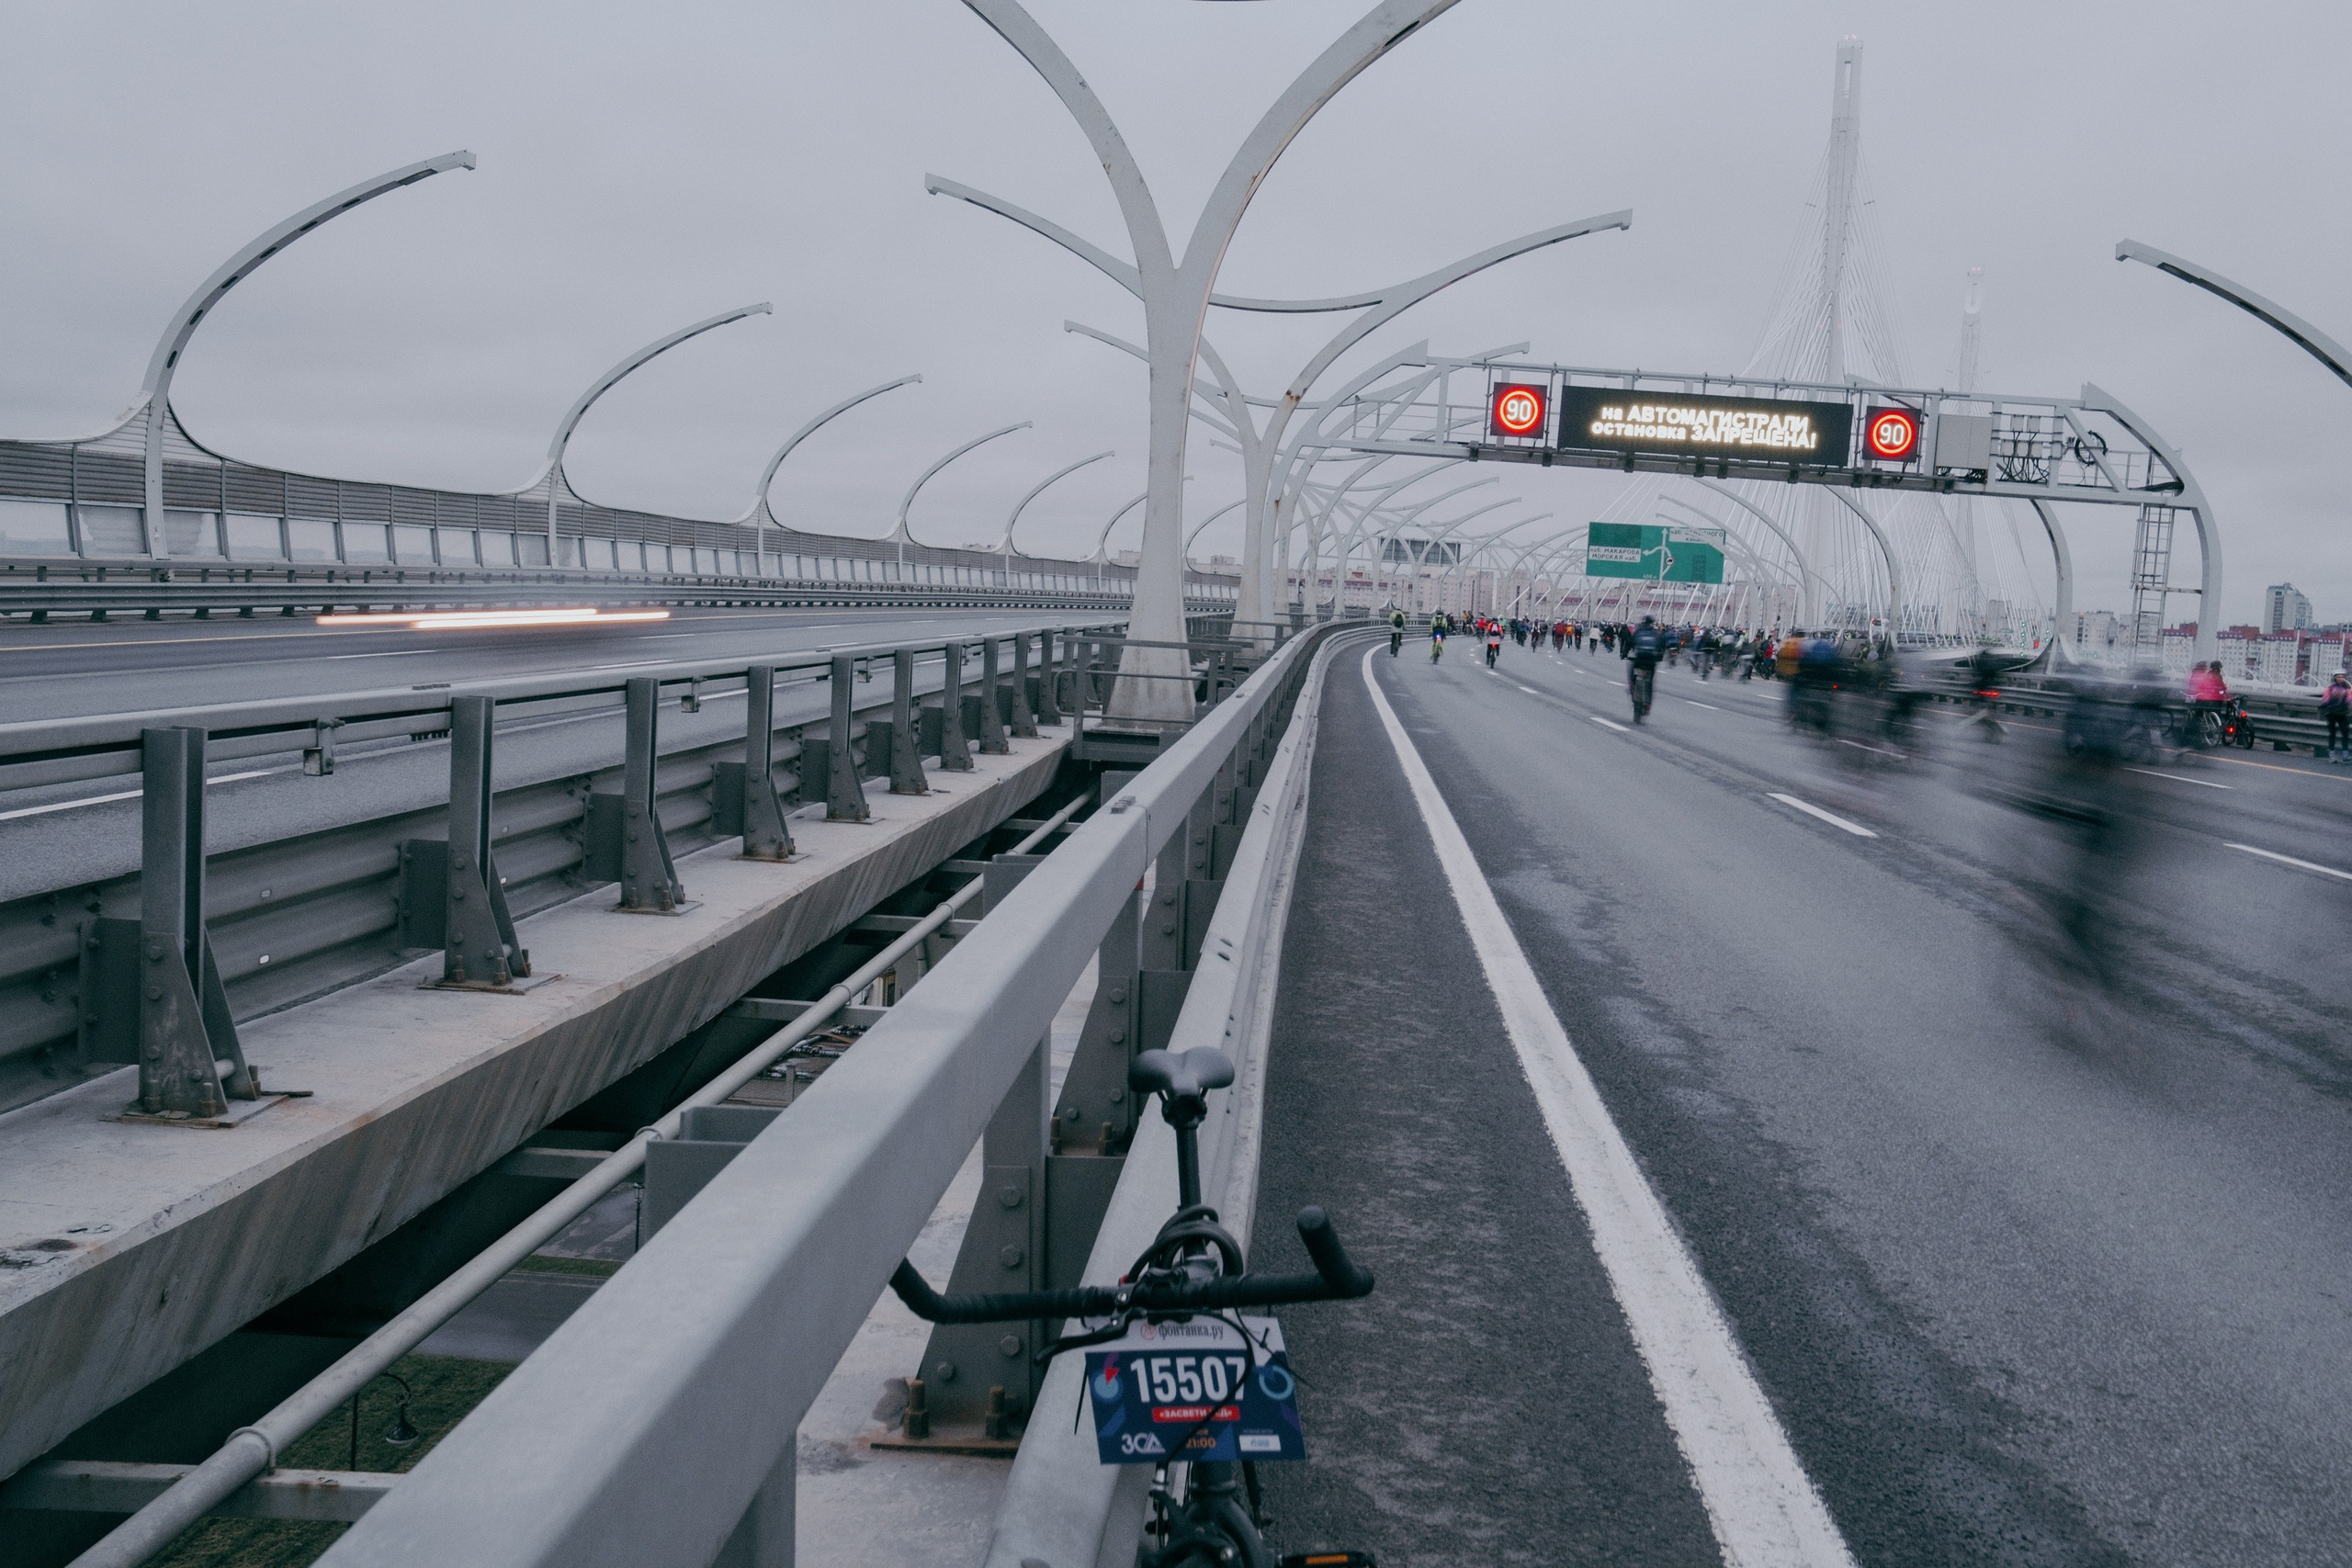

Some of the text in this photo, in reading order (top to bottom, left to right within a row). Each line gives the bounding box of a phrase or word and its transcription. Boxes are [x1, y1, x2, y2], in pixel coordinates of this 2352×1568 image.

[1507, 400, 1532, 422] 90
[1601, 405, 1809, 433] на АВТОМАГИСТРАЛИ
[1591, 422, 1816, 448] остановка ЗАПРЕЩЕНА!
[1880, 423, 1905, 446] 90
[1159, 1324, 1224, 1341] фонтанка.ру
[1130, 1356, 1246, 1404] 15507
